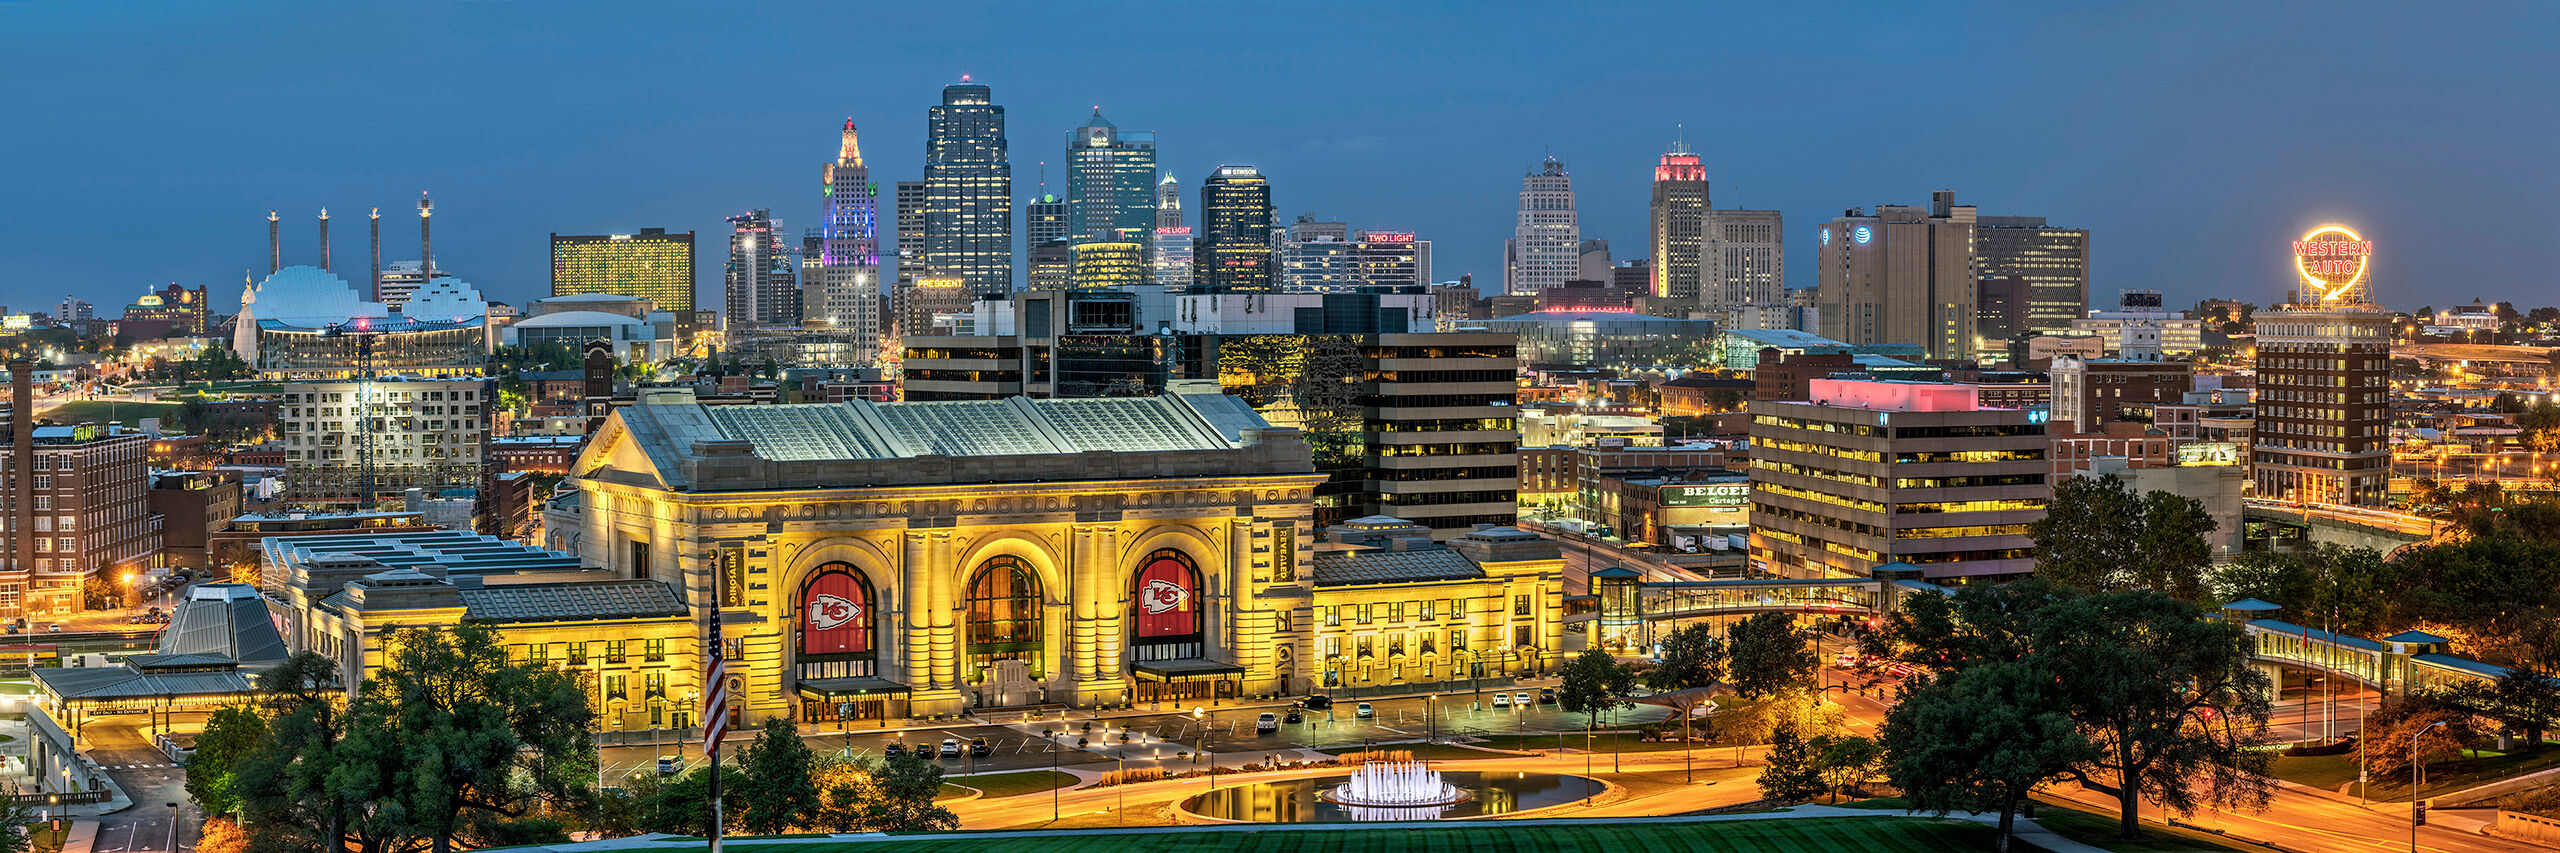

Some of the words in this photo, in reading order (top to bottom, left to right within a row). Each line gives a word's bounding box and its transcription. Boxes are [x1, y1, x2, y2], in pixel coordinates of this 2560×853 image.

[1156, 227, 1171, 235] ONE
[1171, 227, 1192, 235] LIGHT
[1368, 234, 1388, 243] TWO
[1389, 234, 1414, 243] LIGHT
[2293, 240, 2372, 256] WESTERN
[2310, 260, 2356, 275] AUTO
[917, 279, 963, 288] PRESIDENT
[1683, 487, 1749, 496] BELGER
[1279, 530, 1288, 579] REVEALED
[729, 551, 737, 604] DINOSAURS
[1152, 587, 1179, 605] KC
[821, 602, 849, 621] KC
